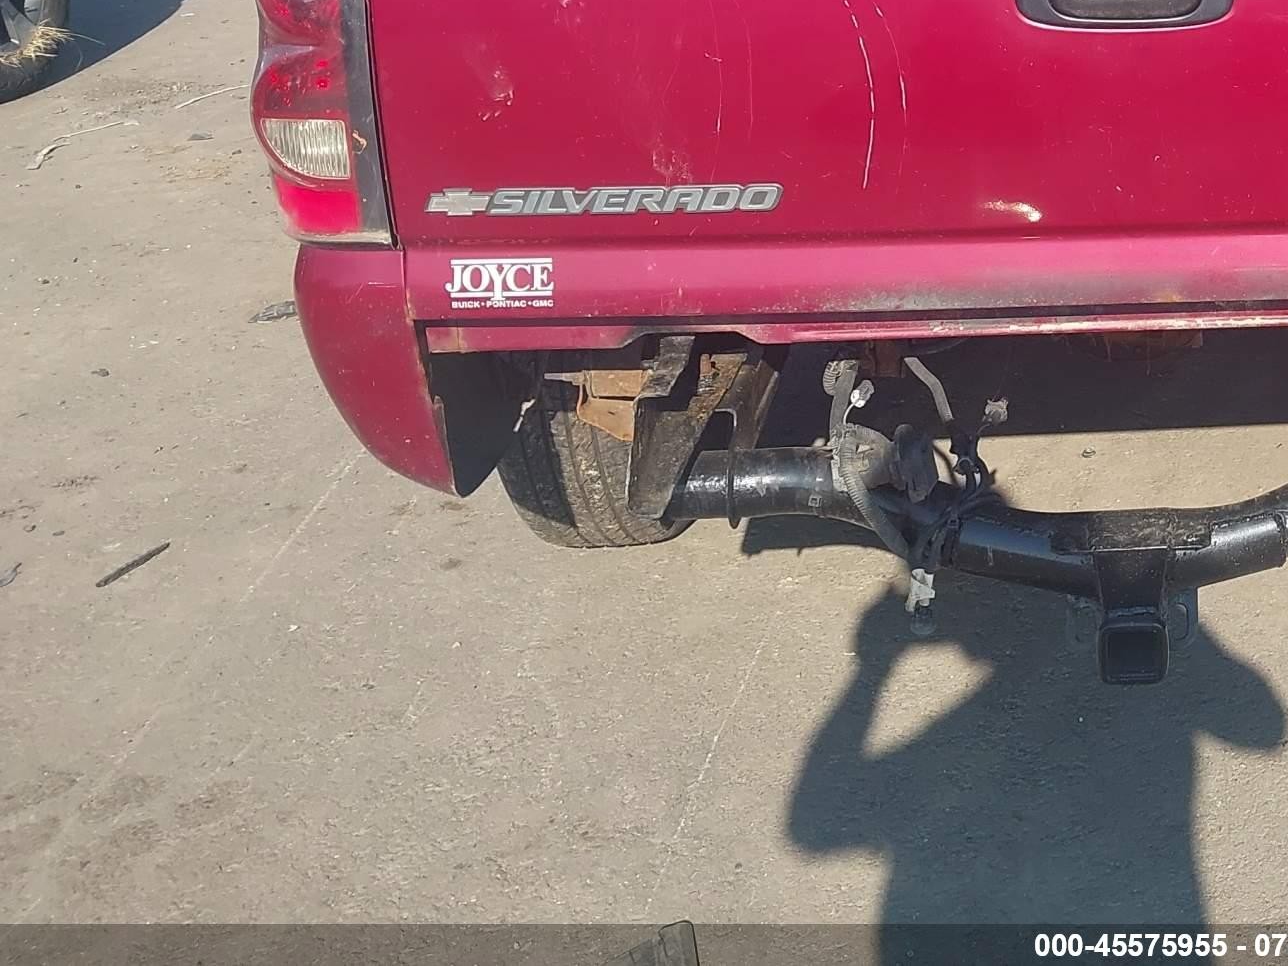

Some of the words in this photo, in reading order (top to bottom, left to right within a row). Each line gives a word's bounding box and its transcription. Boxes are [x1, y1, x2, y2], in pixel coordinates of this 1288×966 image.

[488, 185, 781, 215] SILVERADO
[445, 262, 554, 301] JOYCE
[451, 301, 480, 309] BUICK
[486, 300, 527, 309] PONTIAC
[532, 300, 554, 308] GMC
